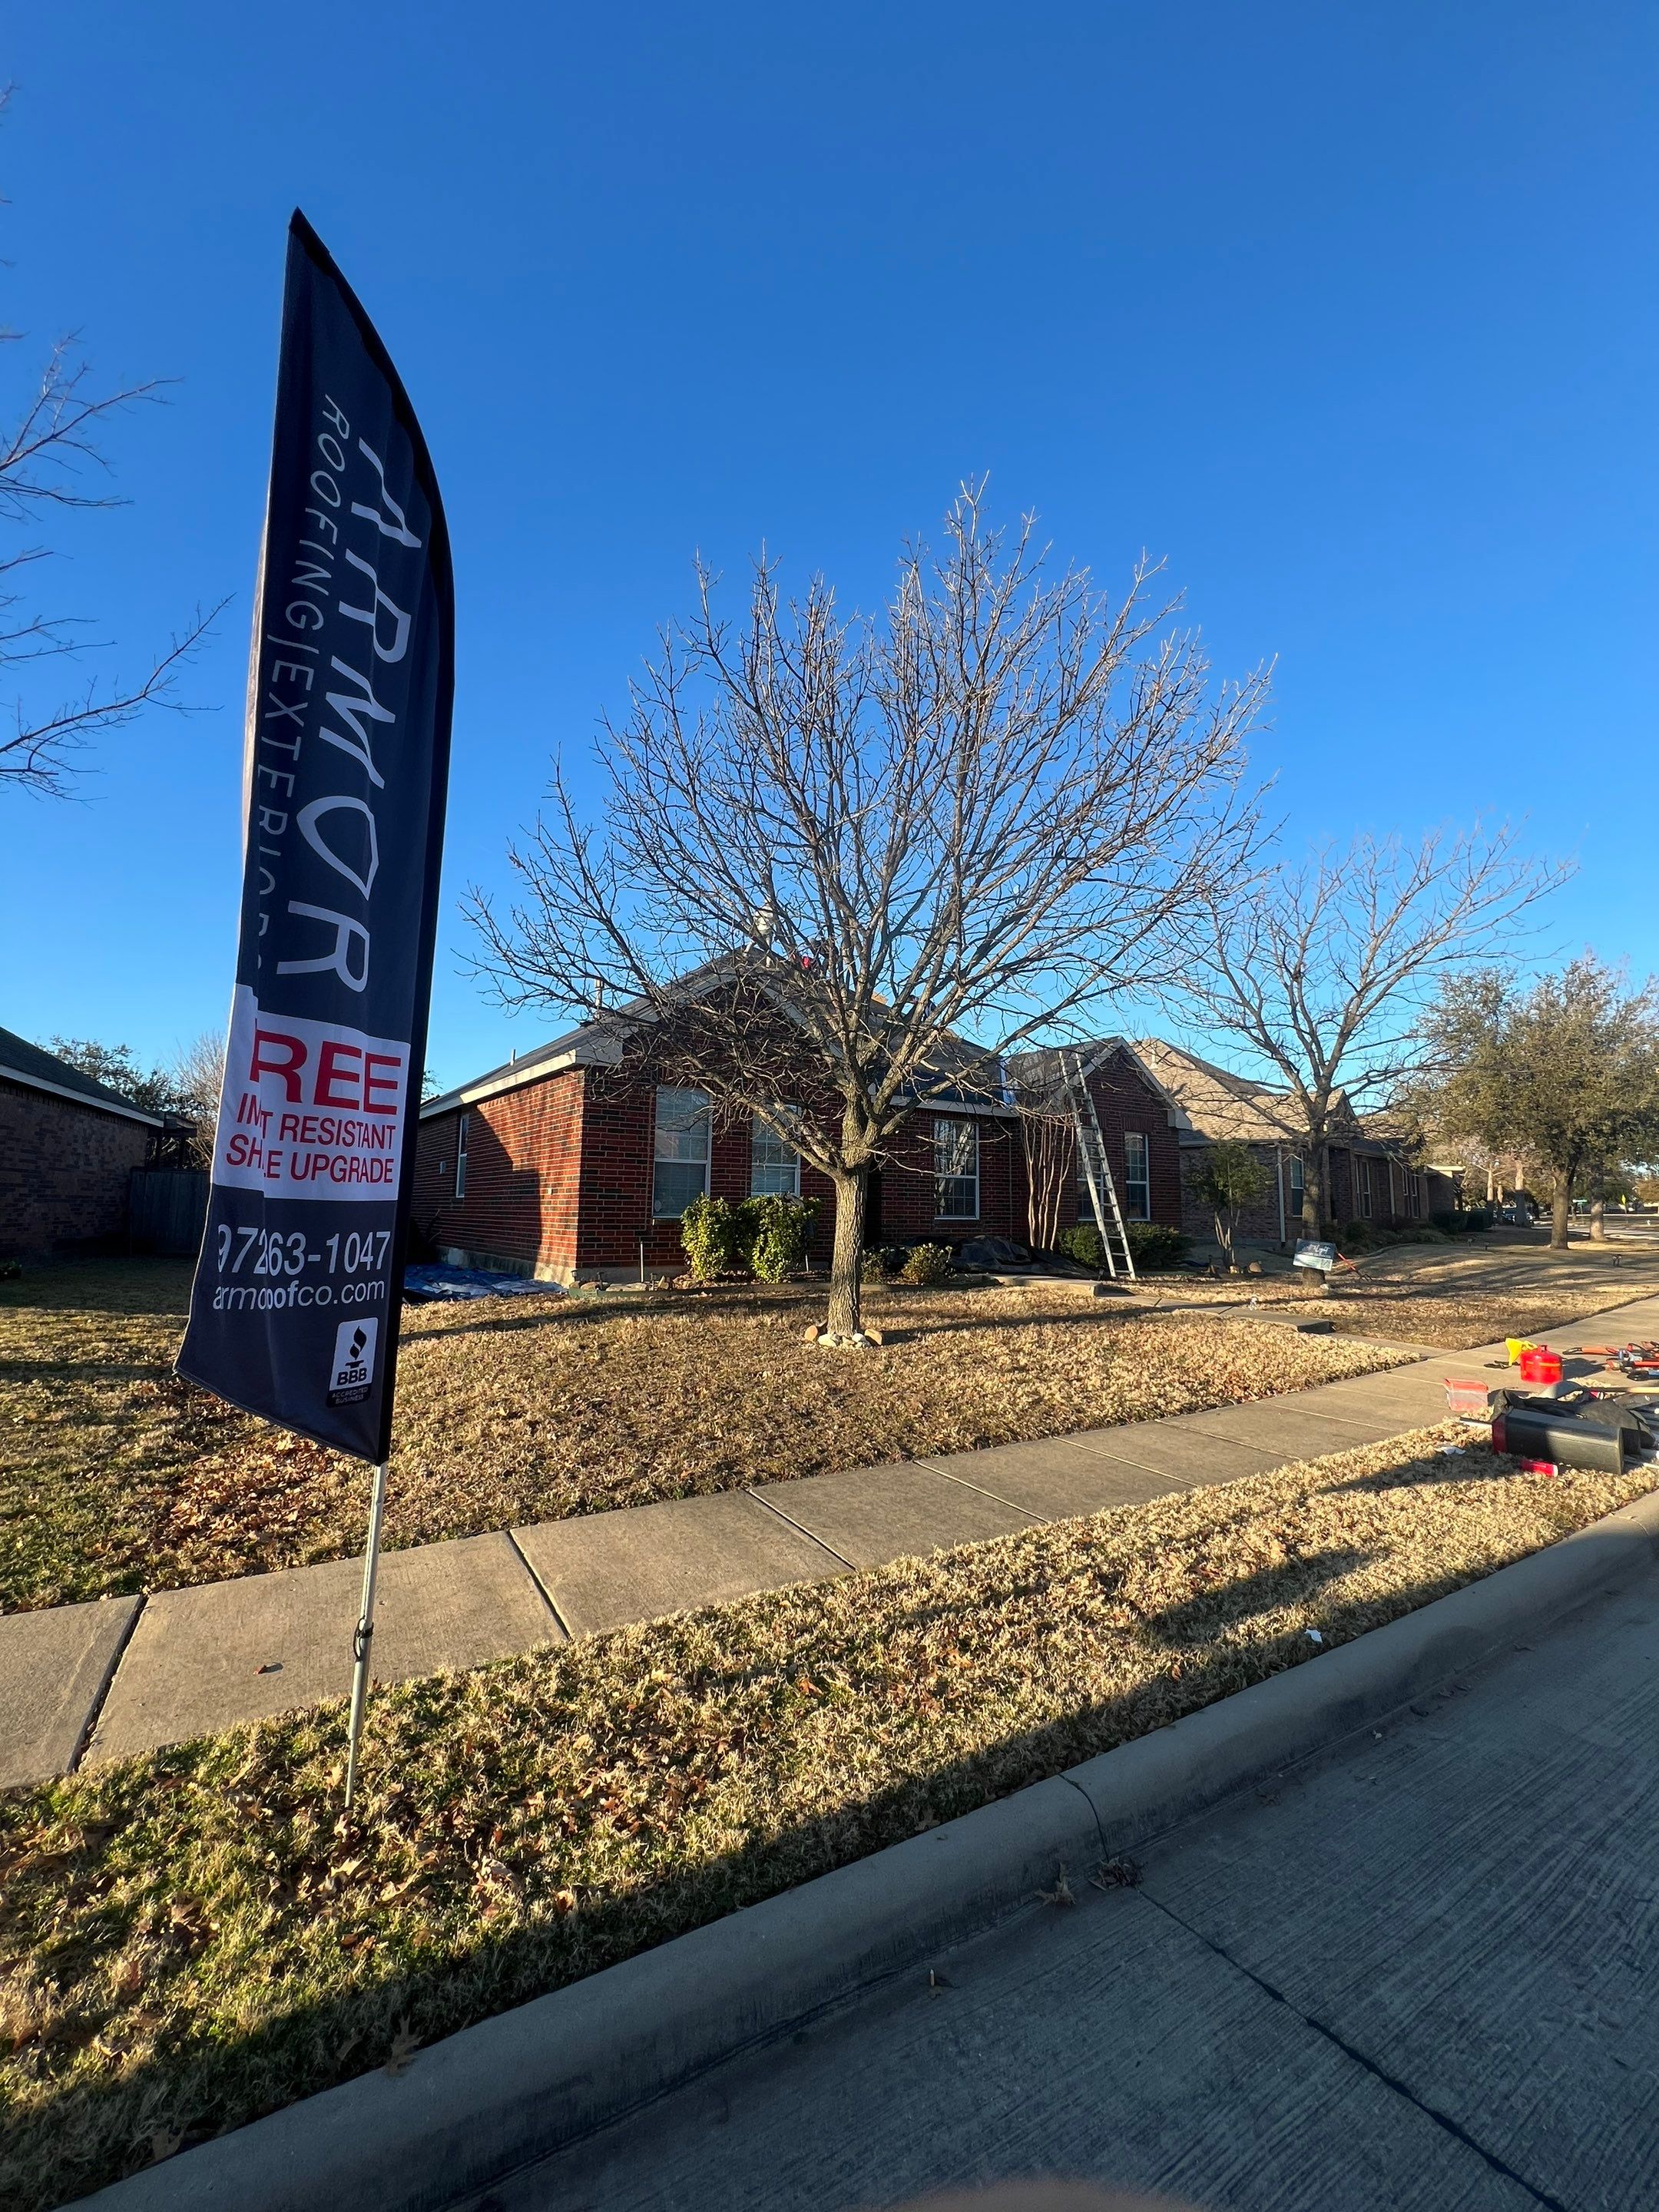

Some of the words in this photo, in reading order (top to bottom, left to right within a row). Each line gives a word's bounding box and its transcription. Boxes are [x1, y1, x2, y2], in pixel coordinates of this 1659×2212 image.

[276, 437, 422, 993] ARMOR
[250, 1028, 402, 1115] REE
[279, 1113, 396, 1150] RESISTANT
[290, 1152, 395, 1184] UPGRADE
[336, 1367, 367, 1386] BBB
